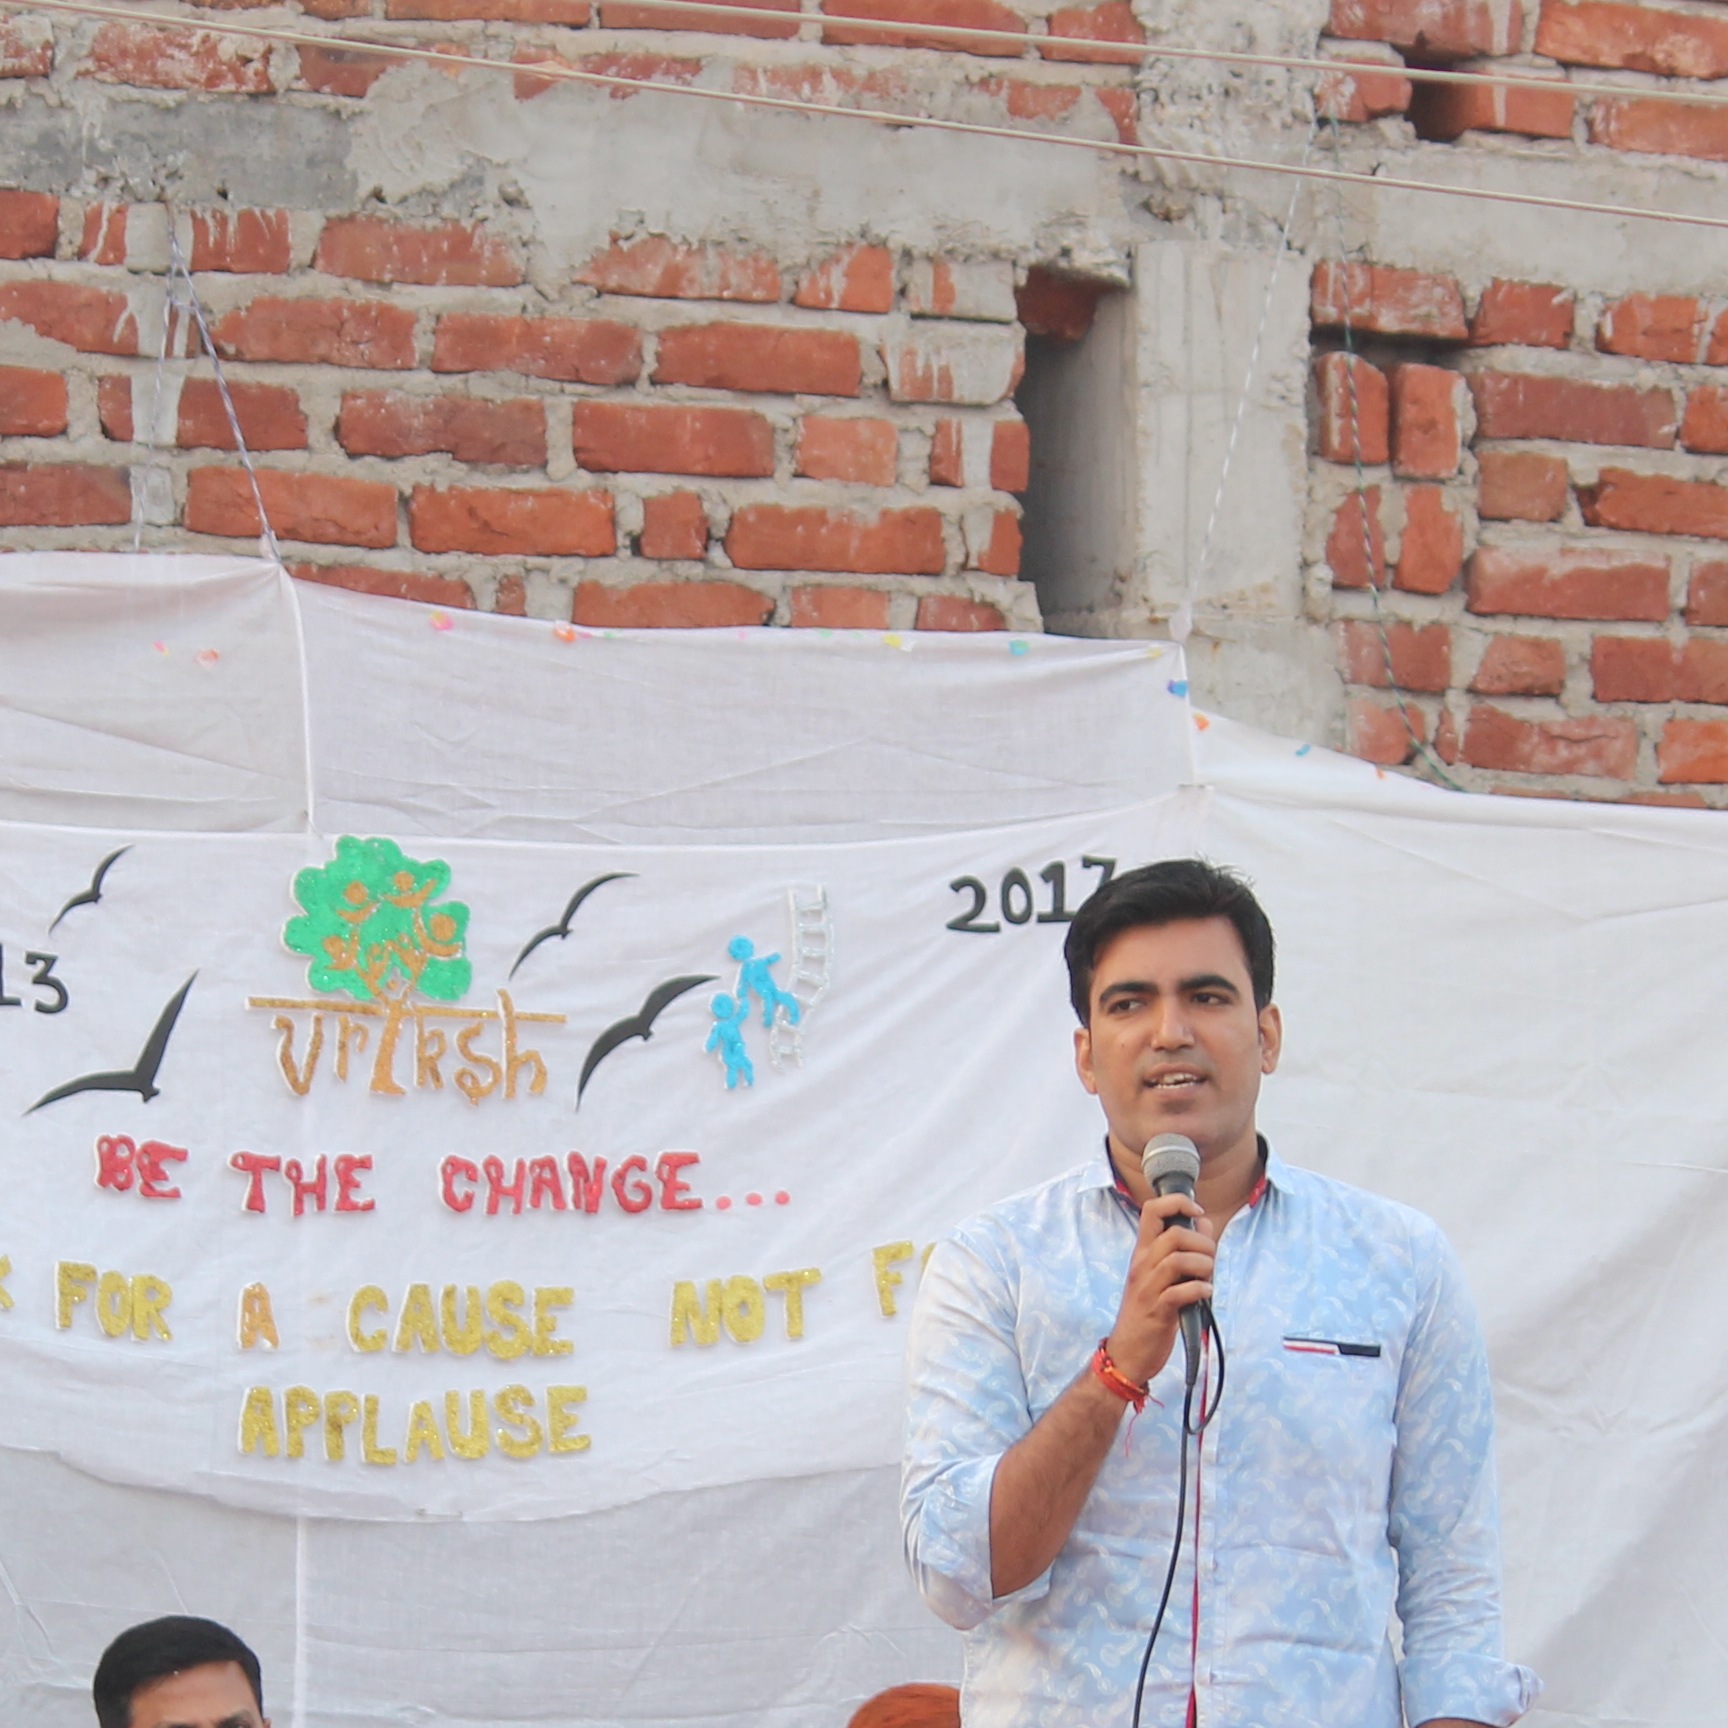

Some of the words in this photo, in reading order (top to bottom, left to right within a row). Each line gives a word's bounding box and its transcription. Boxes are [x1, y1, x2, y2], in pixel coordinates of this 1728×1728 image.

[95, 1134, 189, 1199] BE
[228, 1152, 376, 1216] THE
[439, 1150, 792, 1214] CHANGE...
[56, 1261, 173, 1341] FOR
[237, 1281, 281, 1350] A
[346, 1279, 575, 1360] CAUSE
[670, 1267, 821, 1346] NOT
[873, 1240, 936, 1317] F
[238, 1384, 592, 1465] APPLAUSE
